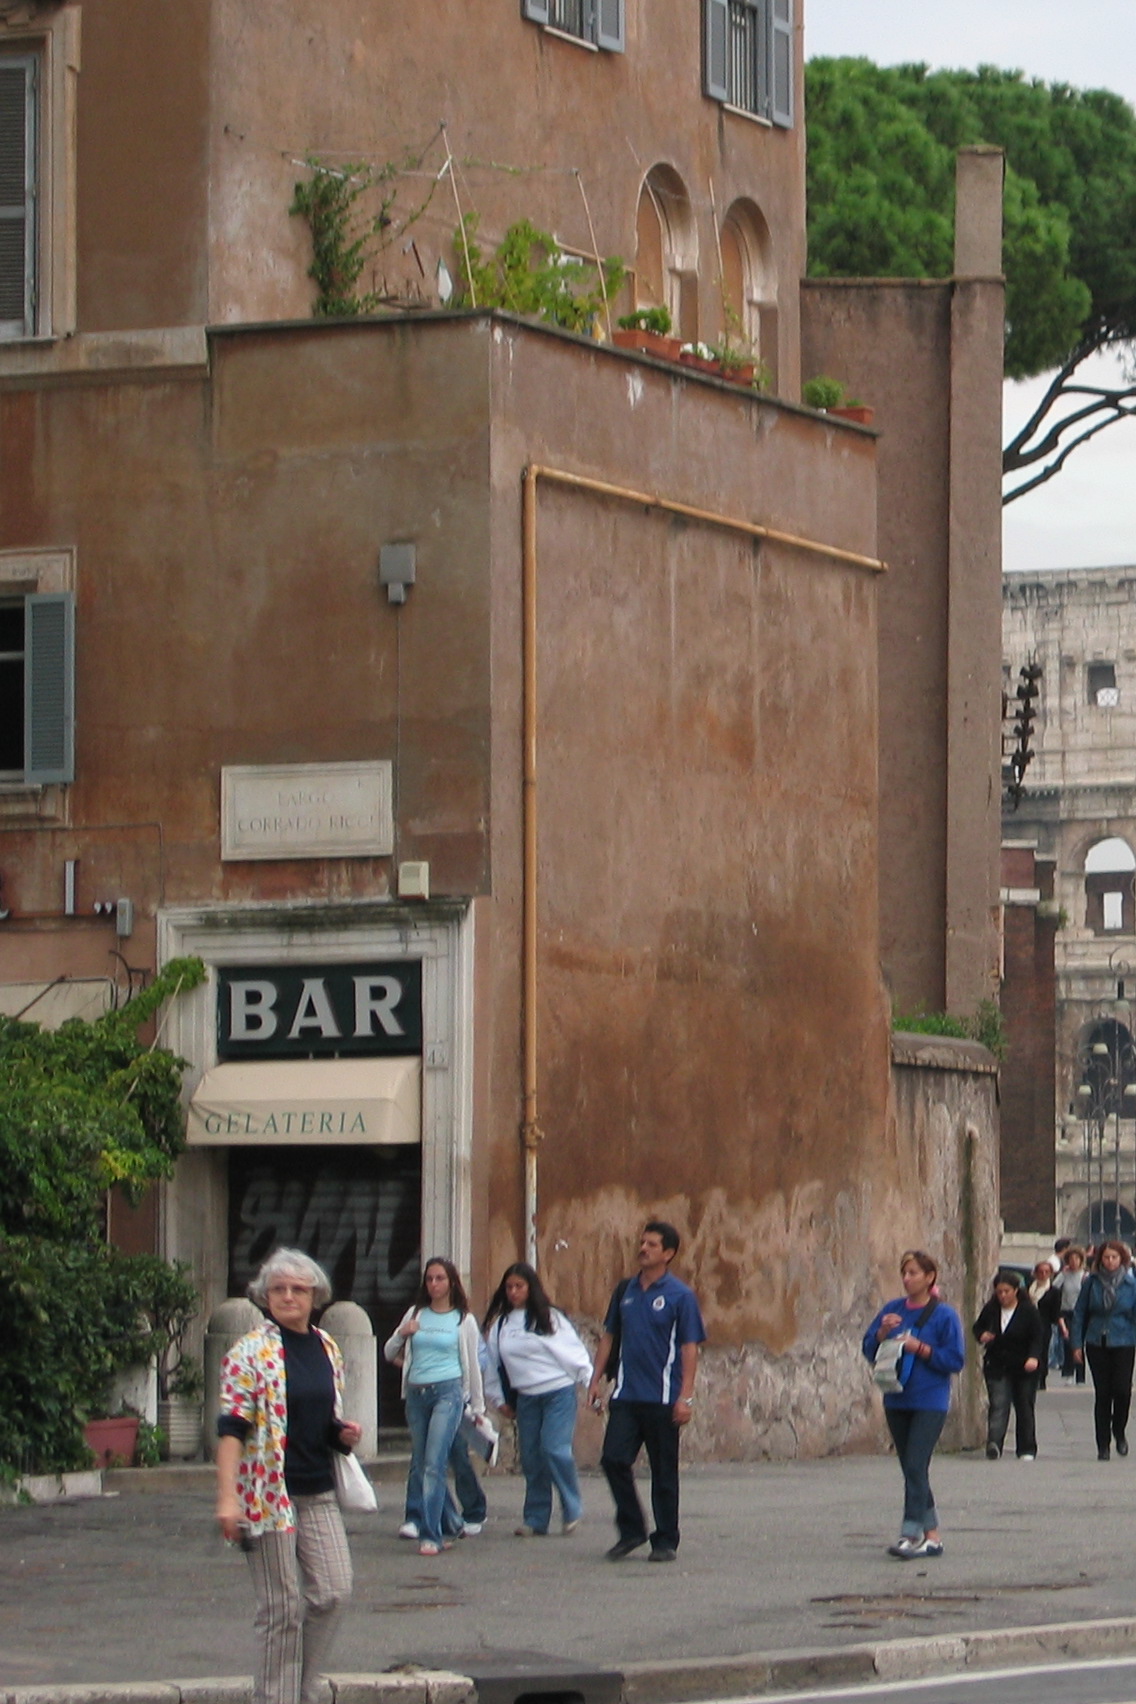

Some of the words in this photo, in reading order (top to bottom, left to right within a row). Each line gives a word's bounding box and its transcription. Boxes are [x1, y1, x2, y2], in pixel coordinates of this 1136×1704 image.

[237, 816, 321, 833] CORRADO
[228, 975, 406, 1041] BAR
[205, 1111, 367, 1135] GELATERIA
